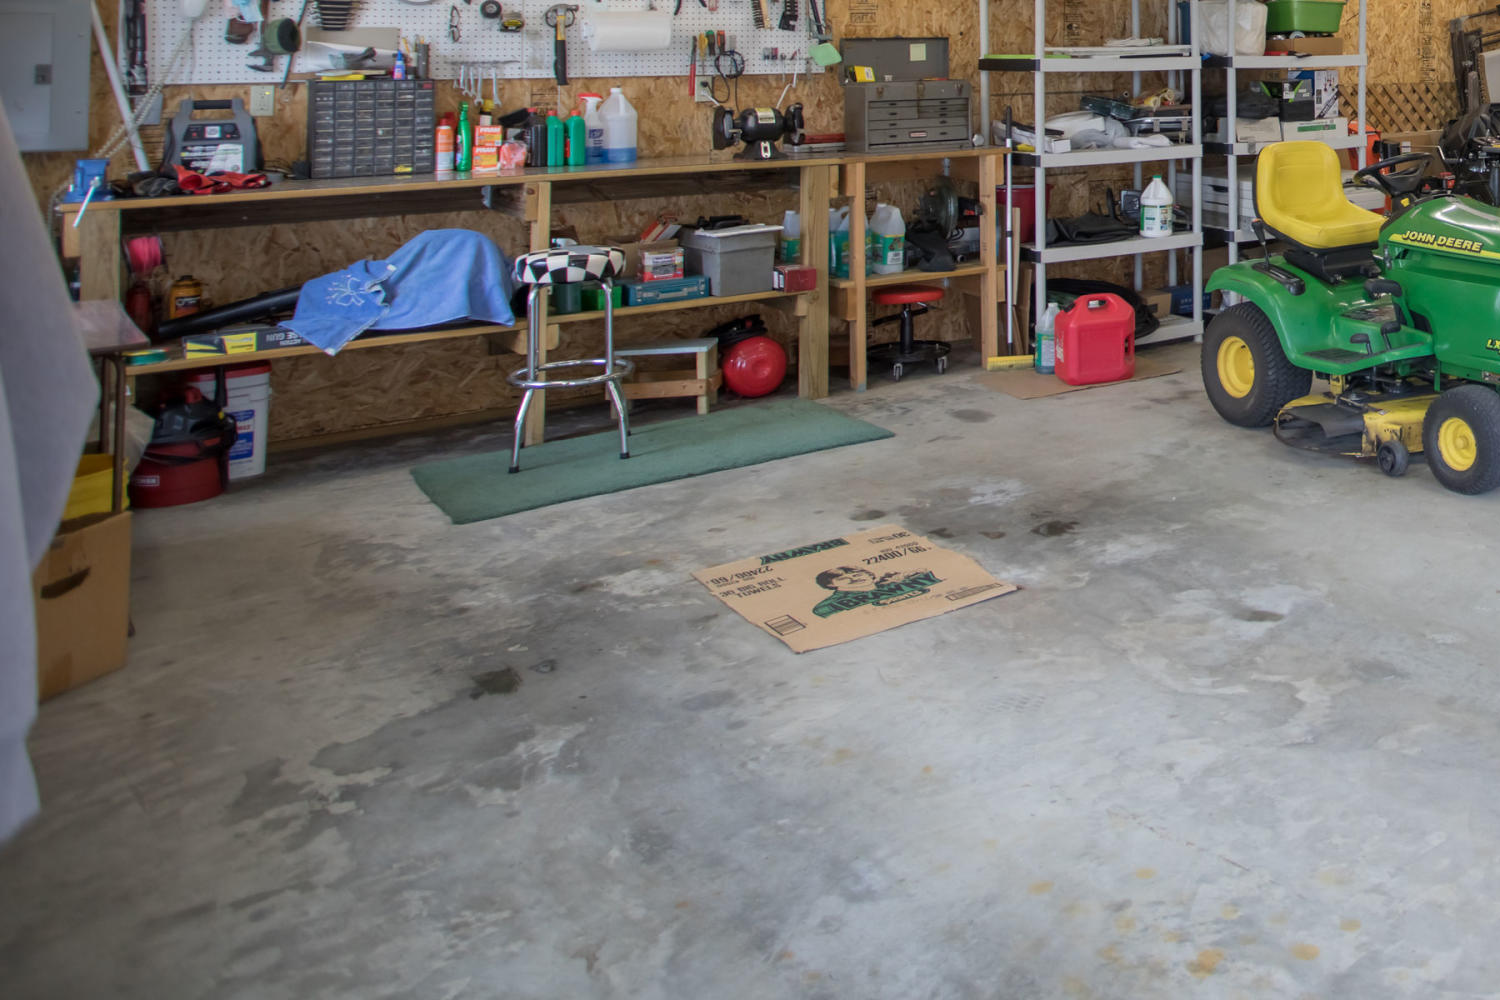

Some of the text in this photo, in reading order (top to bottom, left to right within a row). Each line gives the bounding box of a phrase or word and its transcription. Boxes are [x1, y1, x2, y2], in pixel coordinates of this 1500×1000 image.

[1402, 231, 1484, 253] JOHN DEERE
[836, 573, 938, 611] BRAWNY
